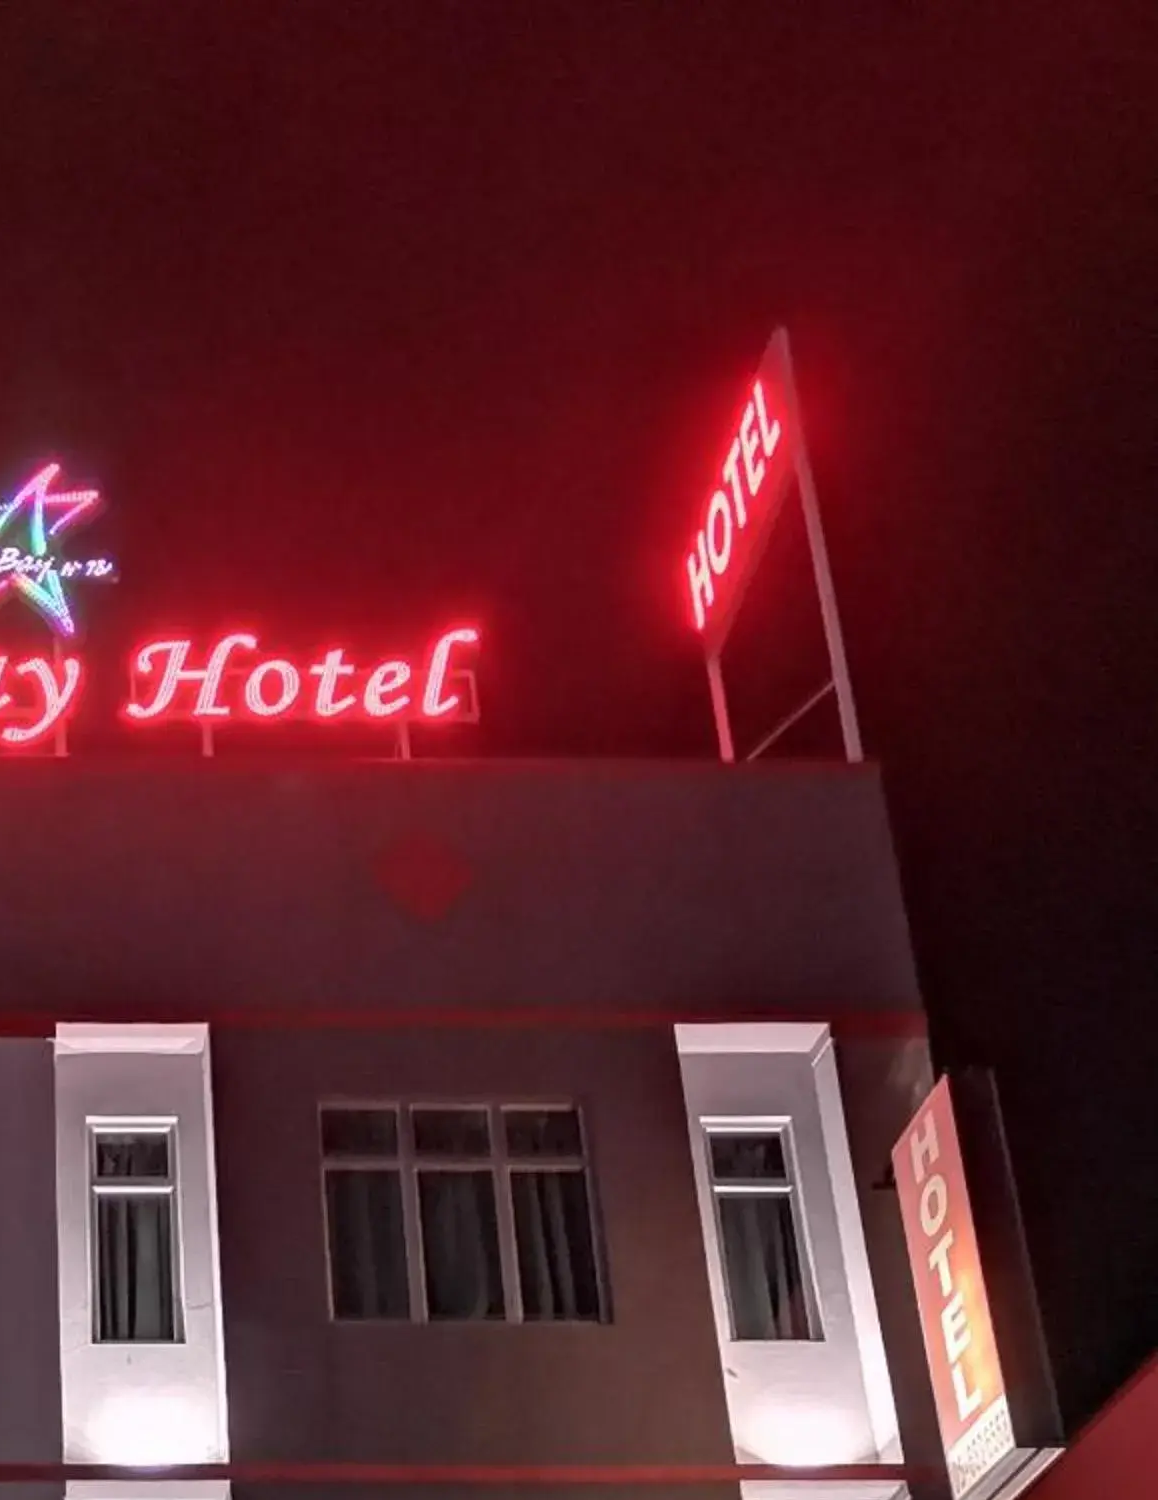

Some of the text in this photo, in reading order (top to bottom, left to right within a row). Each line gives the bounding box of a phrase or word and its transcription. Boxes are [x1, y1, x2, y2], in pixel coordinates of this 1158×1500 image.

[687, 378, 781, 631] HOTEL
[125, 628, 478, 718] Hotel
[909, 1109, 983, 1421] HOTEL
